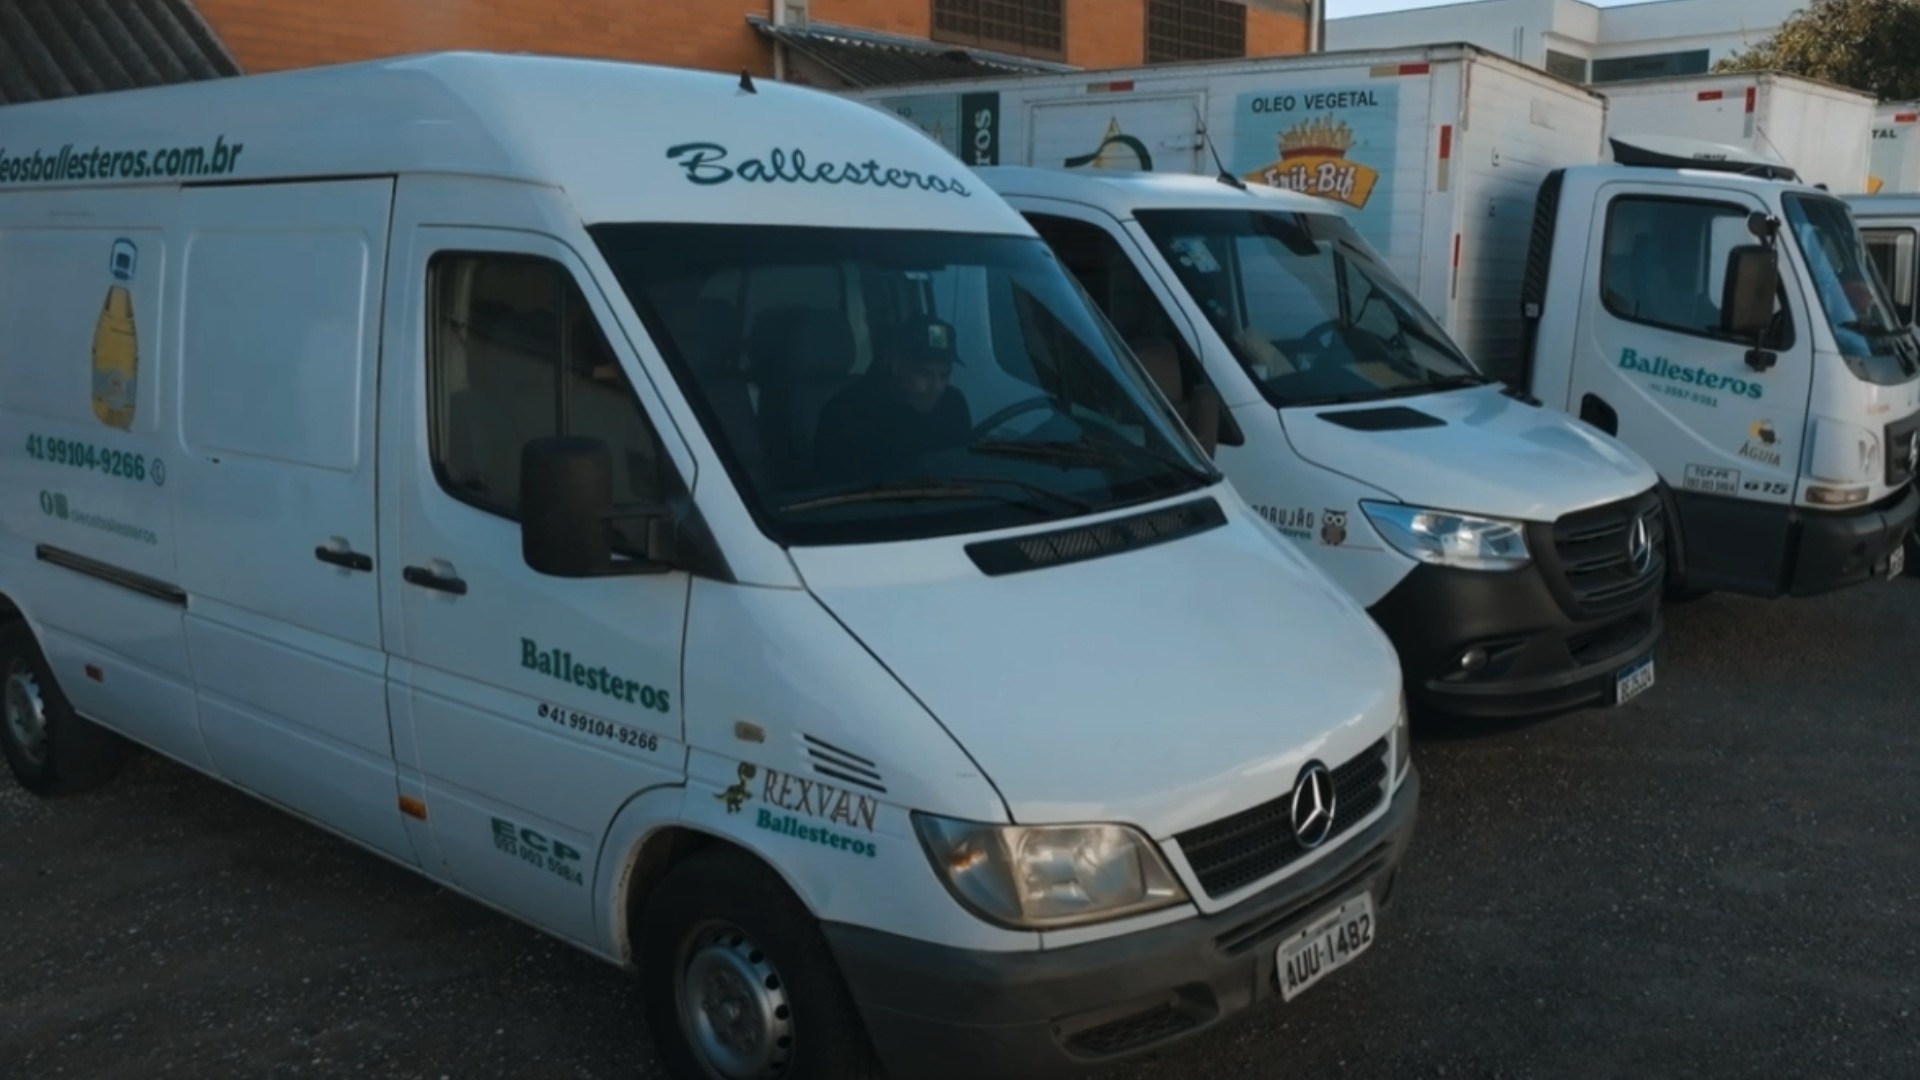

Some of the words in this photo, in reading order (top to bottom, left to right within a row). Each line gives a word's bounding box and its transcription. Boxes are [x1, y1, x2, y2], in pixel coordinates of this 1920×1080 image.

[1251, 97, 1296, 113] OLEO
[1303, 91, 1379, 110] VEGETAL
[666, 142, 971, 197] Ballesteros
[1617, 347, 1763, 399] Ballesteros
[26, 433, 44, 460] 41
[47, 437, 145, 481] 99104-9266
[1738, 440, 1781, 467] ÁGUIA
[521, 637, 670, 713] Ballesteros
[550, 707, 566, 725] 41
[569, 711, 658, 752] 99104-9266
[763, 769, 877, 833] REXVAN
[491, 817, 581, 861] ECP
[756, 808, 877, 858] Ballesteros
